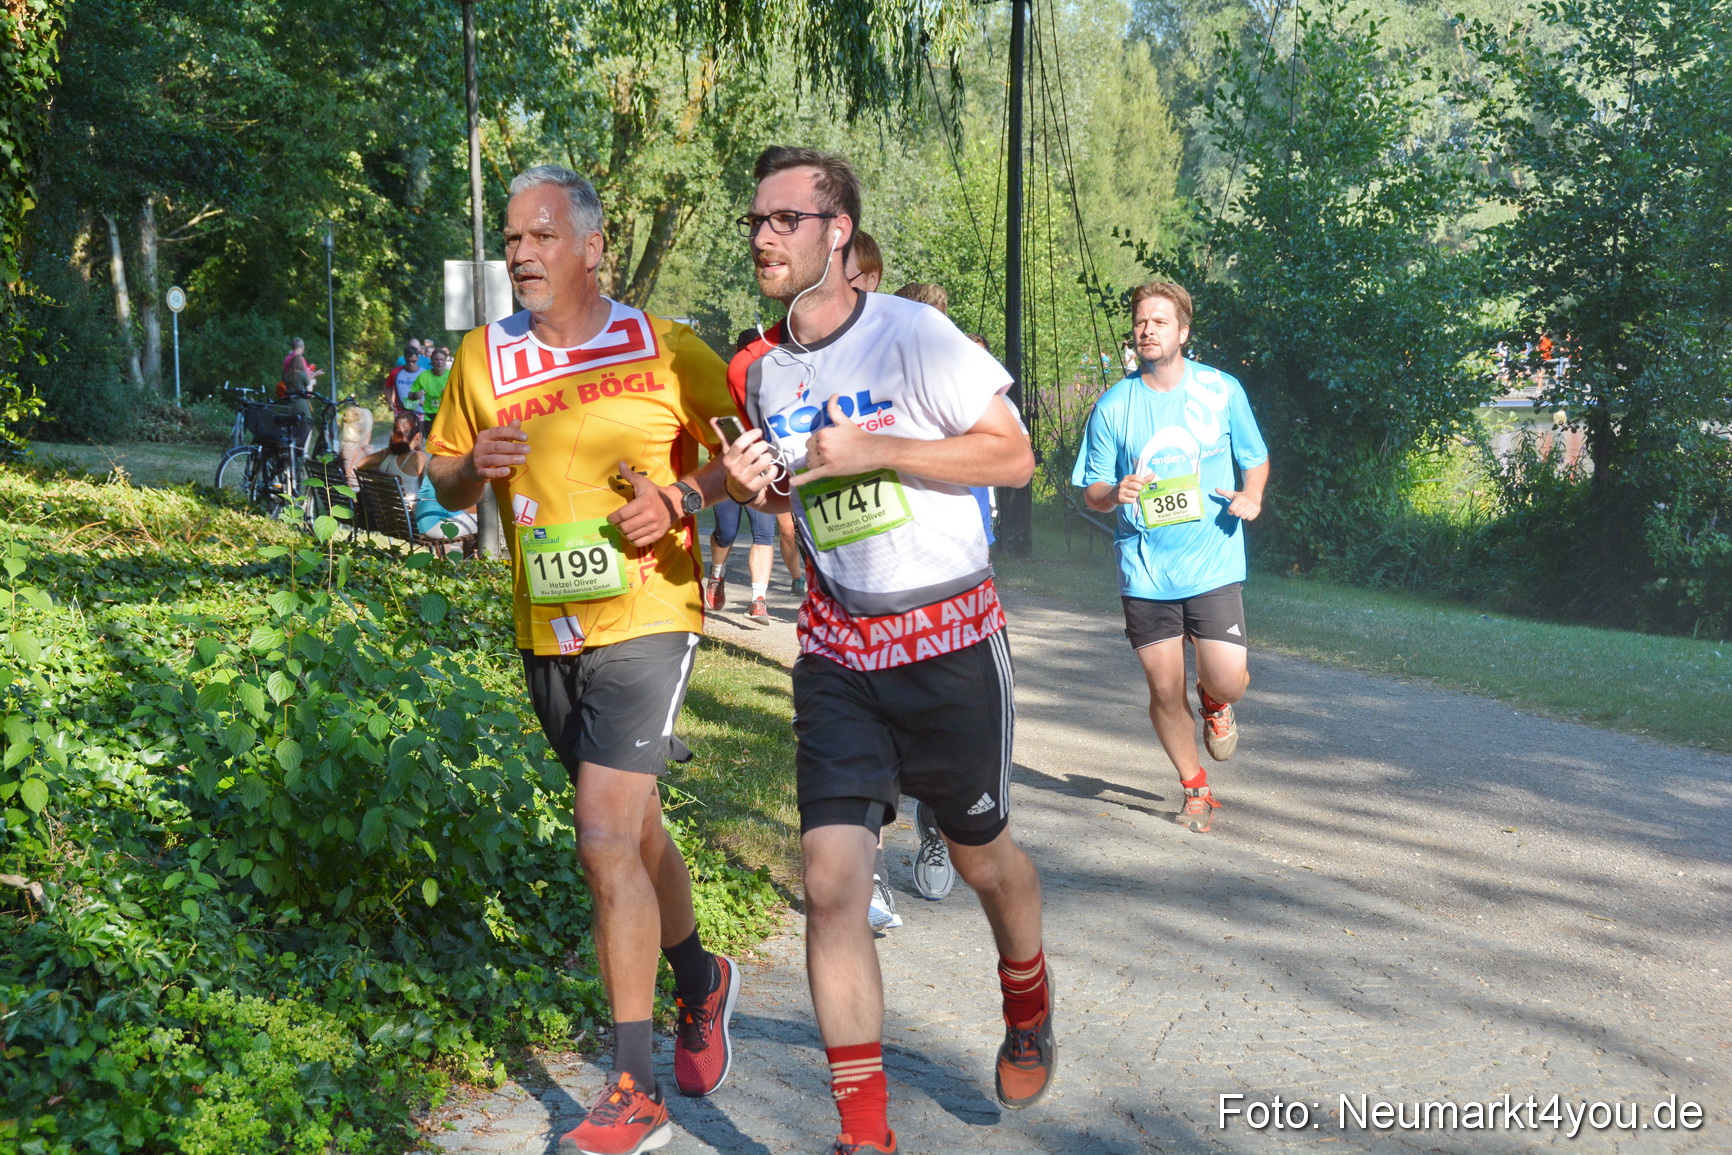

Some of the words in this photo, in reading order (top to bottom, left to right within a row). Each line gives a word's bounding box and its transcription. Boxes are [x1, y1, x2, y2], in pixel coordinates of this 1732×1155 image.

[496, 389, 570, 426] MAX
[577, 371, 665, 405] BÖGL
[1151, 454, 1187, 465] anders
[813, 477, 883, 524] 1747
[1153, 493, 1188, 514] 386
[826, 518, 861, 534] Wittmann
[862, 509, 887, 523] Oliver
[855, 522, 873, 533] GmbH
[533, 547, 609, 581] 1199
[549, 580, 573, 589] Hetzel
[573, 578, 598, 587] Oliver
[563, 587, 593, 595] Bauservice
[593, 583, 611, 591] GmbH
[870, 609, 933, 647] AVIA
[941, 585, 994, 625] AVIA
[915, 621, 981, 662] AVIA
[967, 800, 996, 816] adidas
